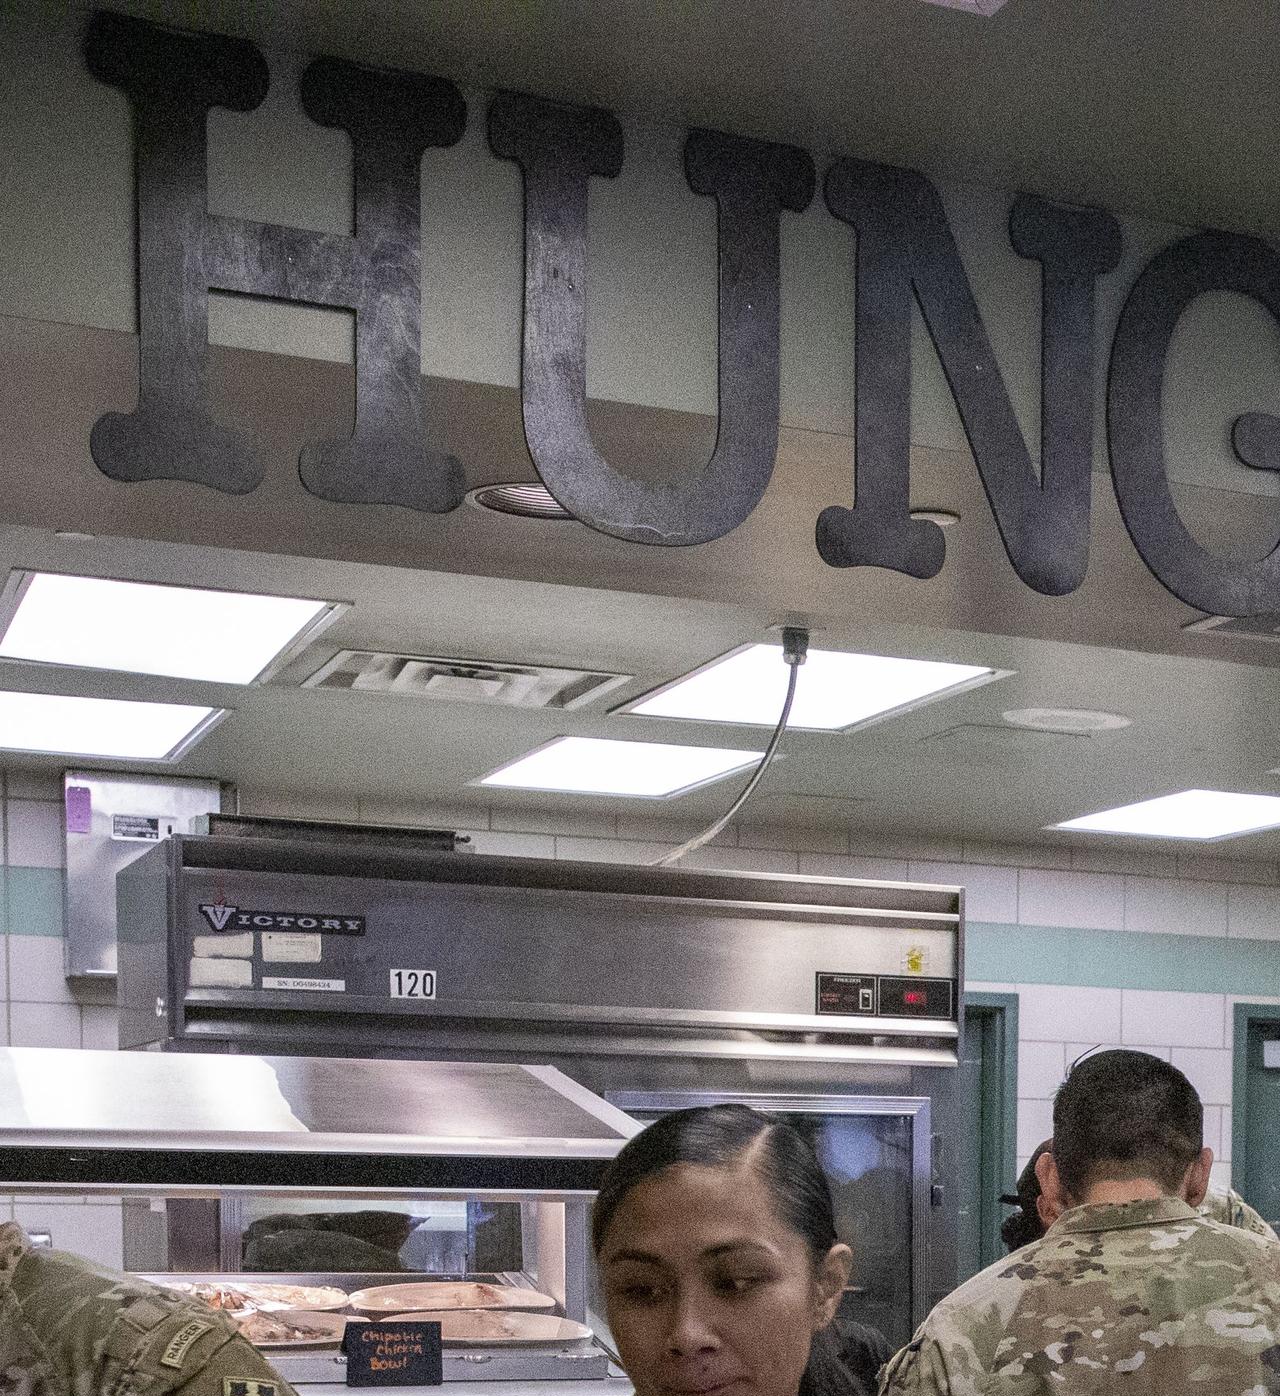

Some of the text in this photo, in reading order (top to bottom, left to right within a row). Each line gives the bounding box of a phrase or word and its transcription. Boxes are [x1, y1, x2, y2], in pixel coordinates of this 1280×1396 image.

[202, 905, 361, 932] VICTORY
[394, 970, 434, 996] 120
[167, 1324, 200, 1360] RANGER
